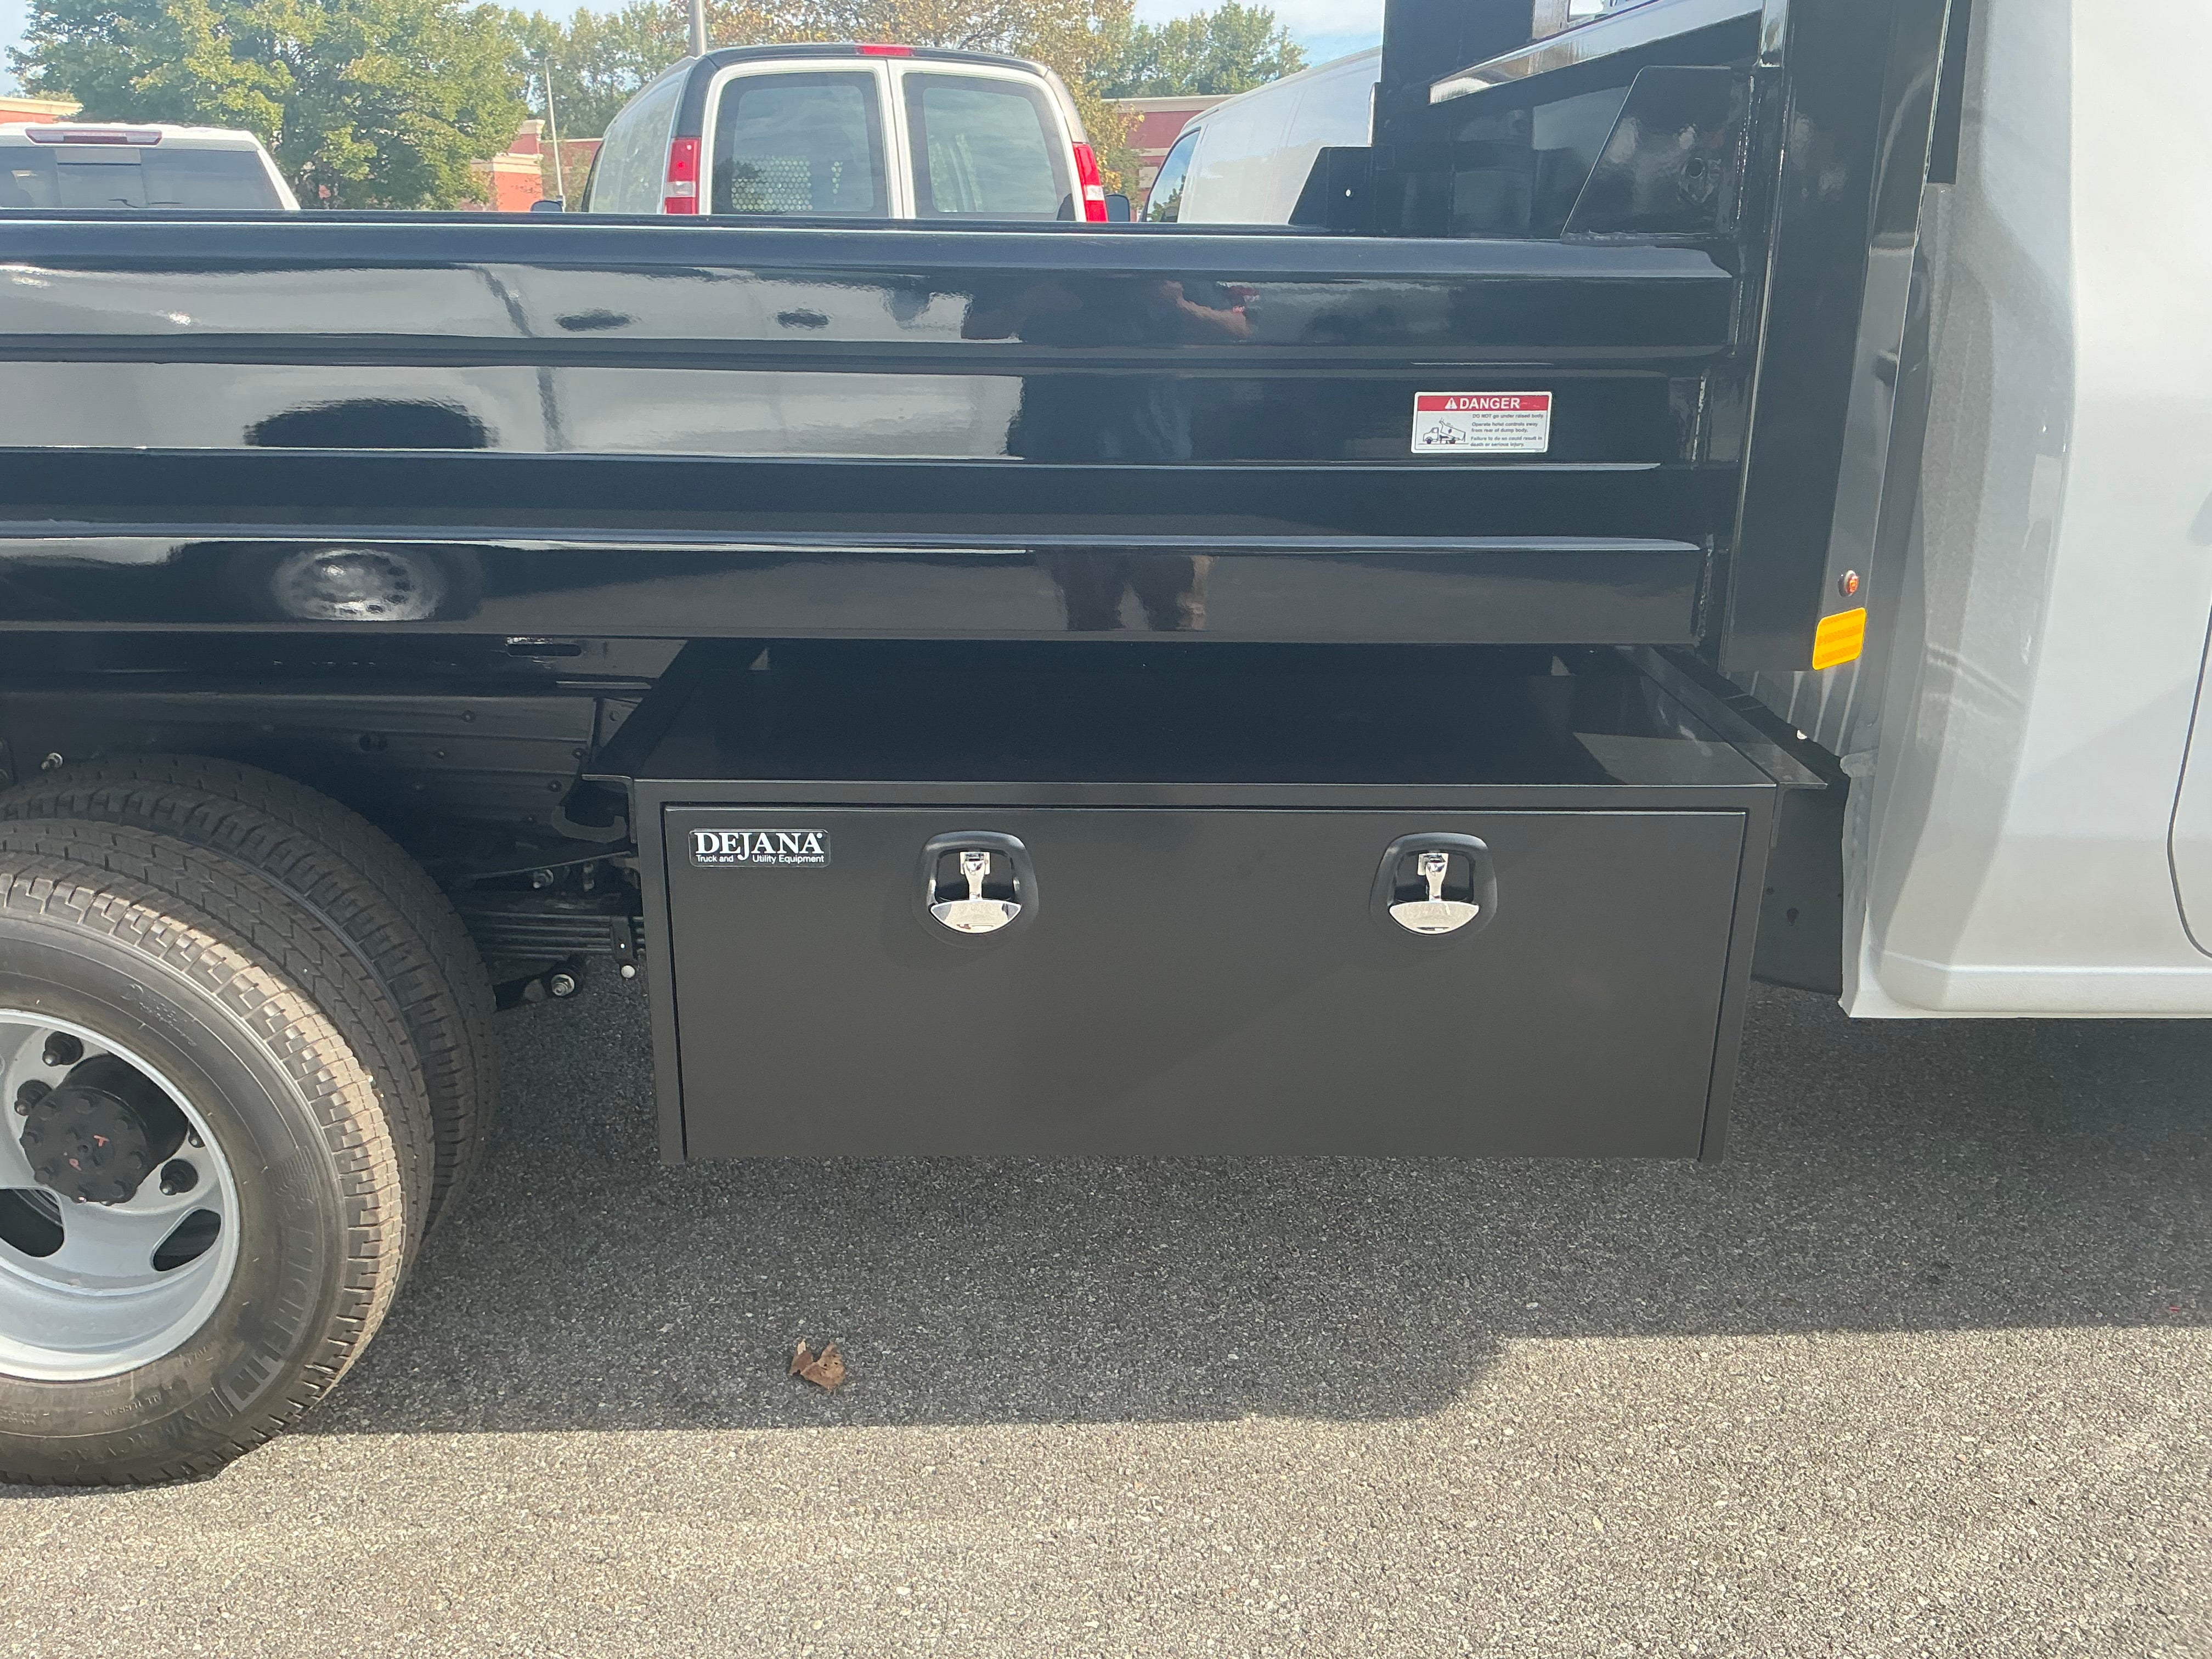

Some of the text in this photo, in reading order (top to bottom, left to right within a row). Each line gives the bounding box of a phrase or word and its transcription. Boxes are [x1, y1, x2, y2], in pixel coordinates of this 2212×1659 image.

[1459, 398, 1520, 409] DANGER
[694, 832, 825, 861] DEJANA
[696, 854, 825, 865] Truck and Utility Equipment
